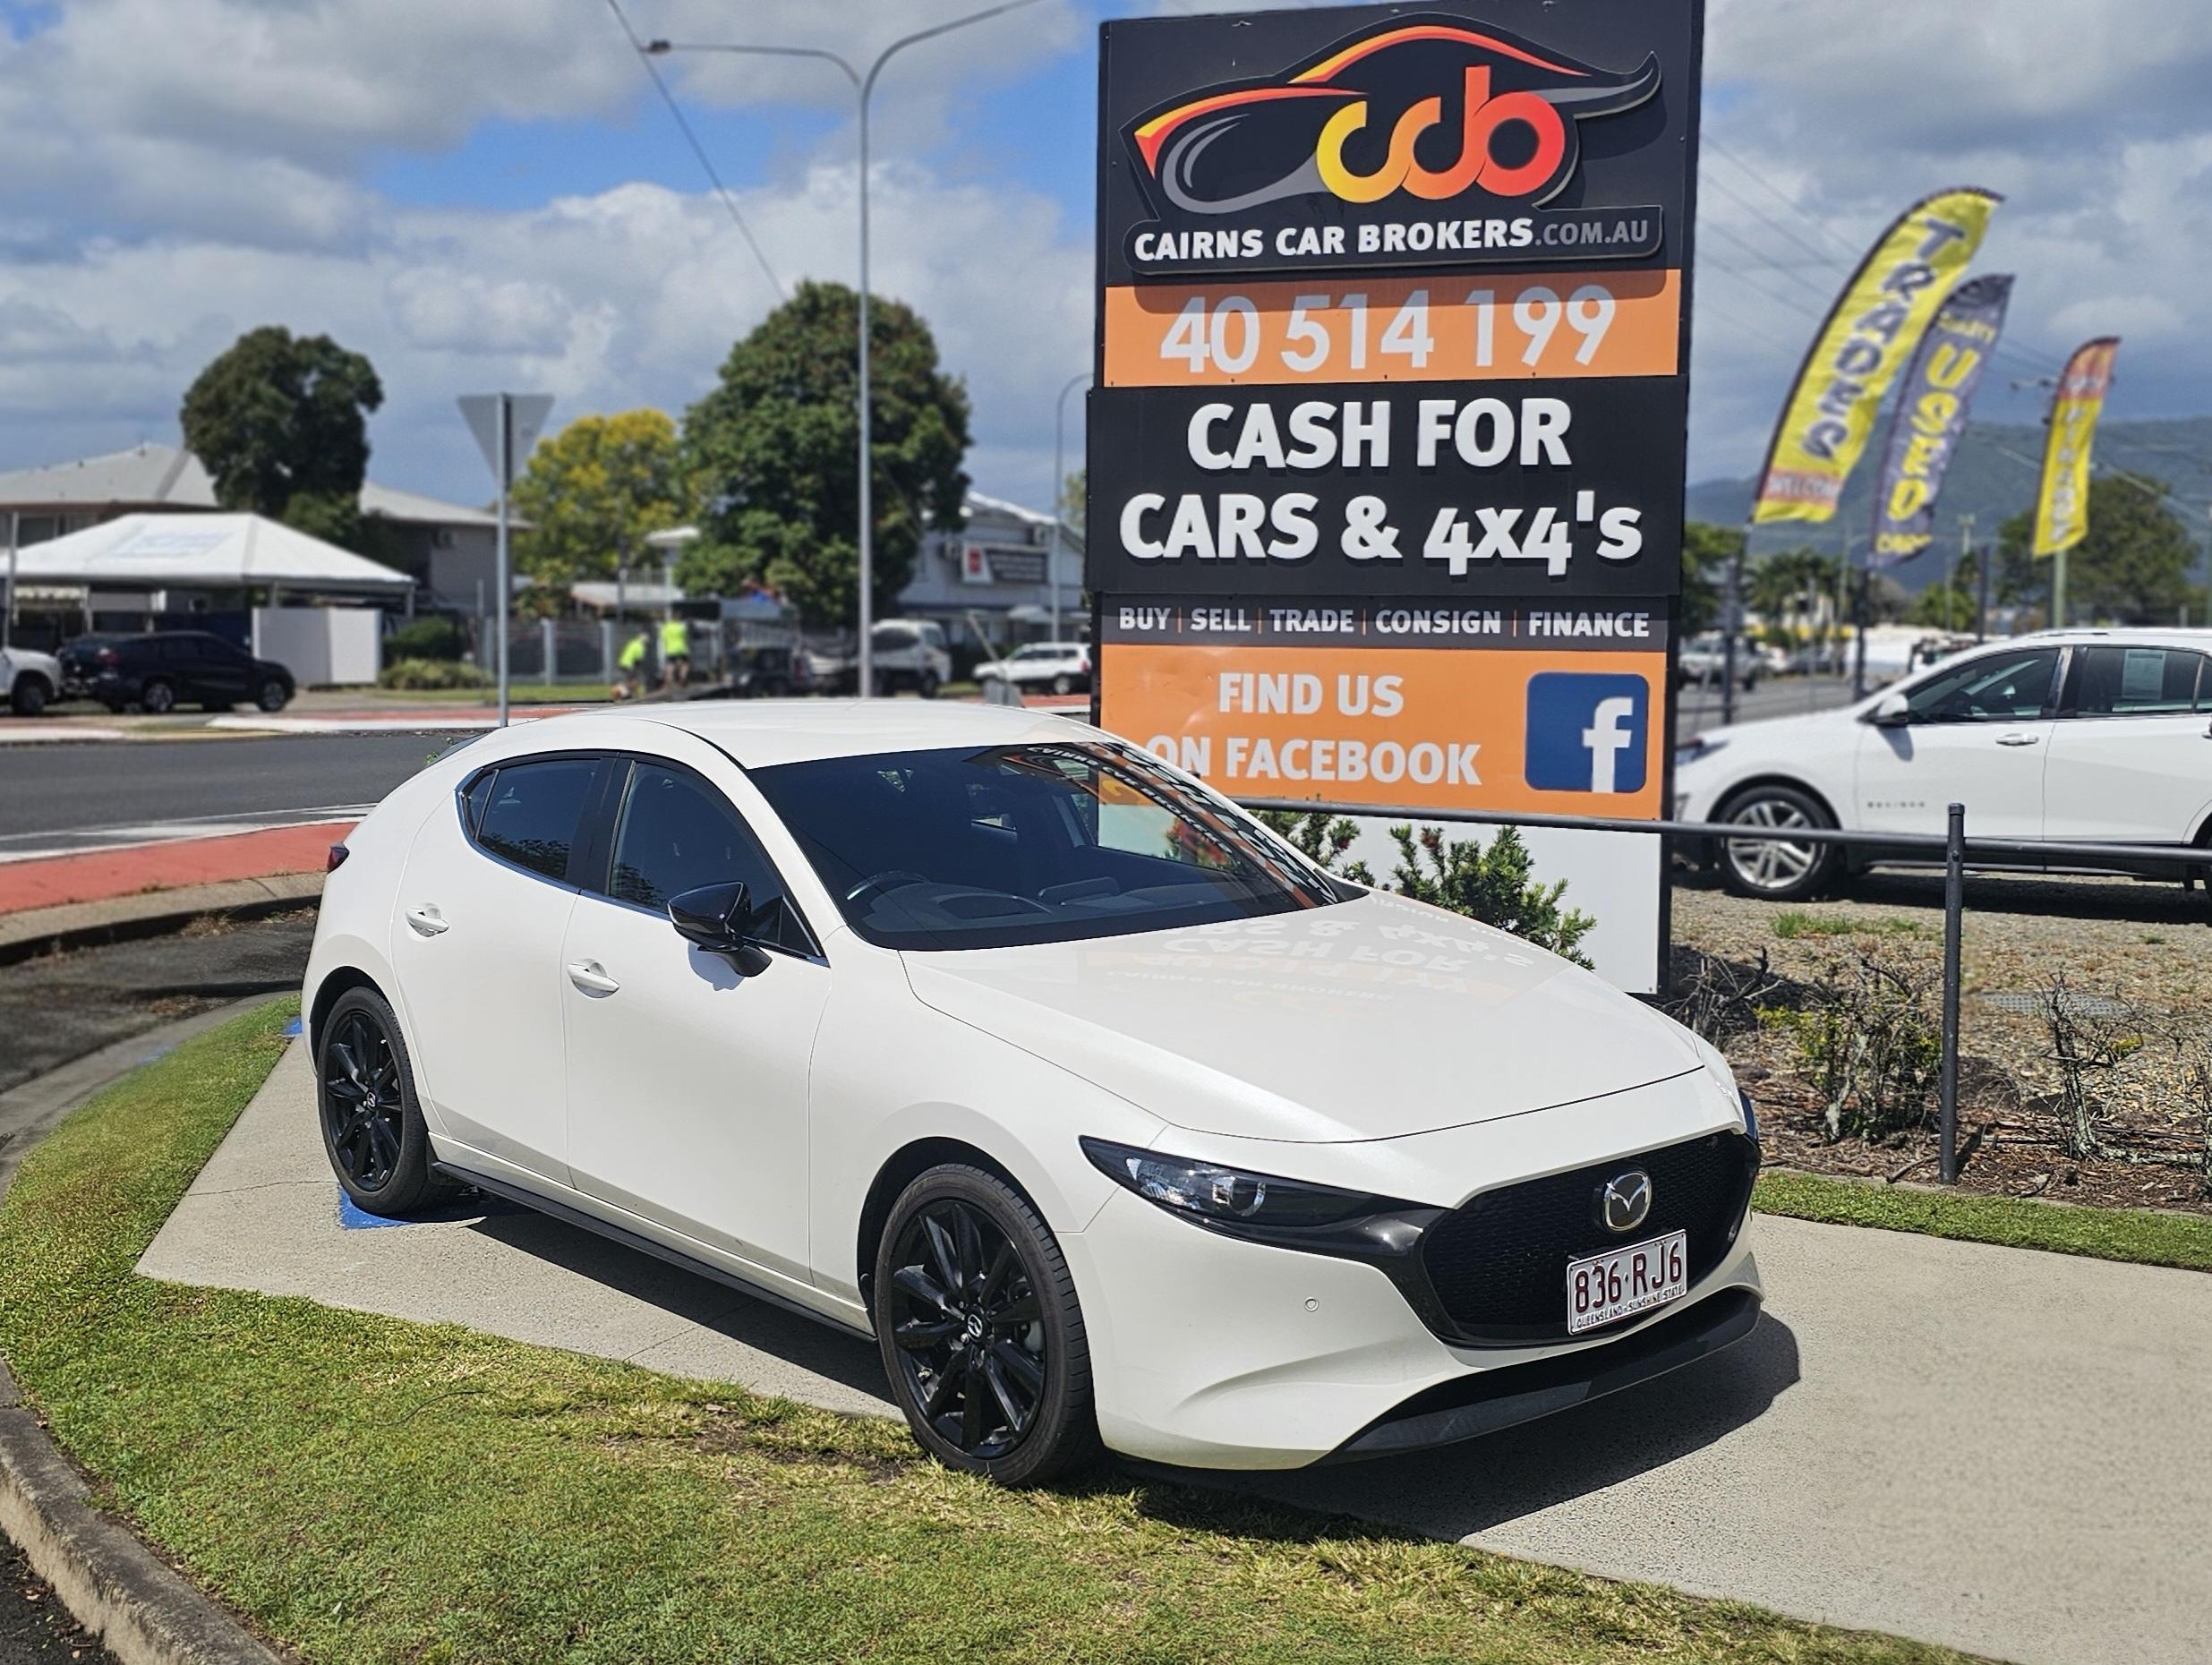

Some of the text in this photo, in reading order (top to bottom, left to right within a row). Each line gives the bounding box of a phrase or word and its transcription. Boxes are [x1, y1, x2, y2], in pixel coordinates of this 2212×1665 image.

[1134, 218, 1649, 260] CAIRNS CAR BROKERS.COM.AU
[1161, 285, 1616, 373] 40 514 199
[1800, 218, 1965, 461] TRADES
[1187, 397, 1572, 470] CASH FOR
[1887, 343, 1979, 521] USED
[1119, 492, 1320, 559] CARS
[1341, 495, 1403, 559] &
[1119, 608, 1650, 637] BUY SELL TRADE CONSIGN FINANCE
[1218, 672, 1405, 716] FIND US
[1146, 736, 1482, 786] ON FACEBOOK
